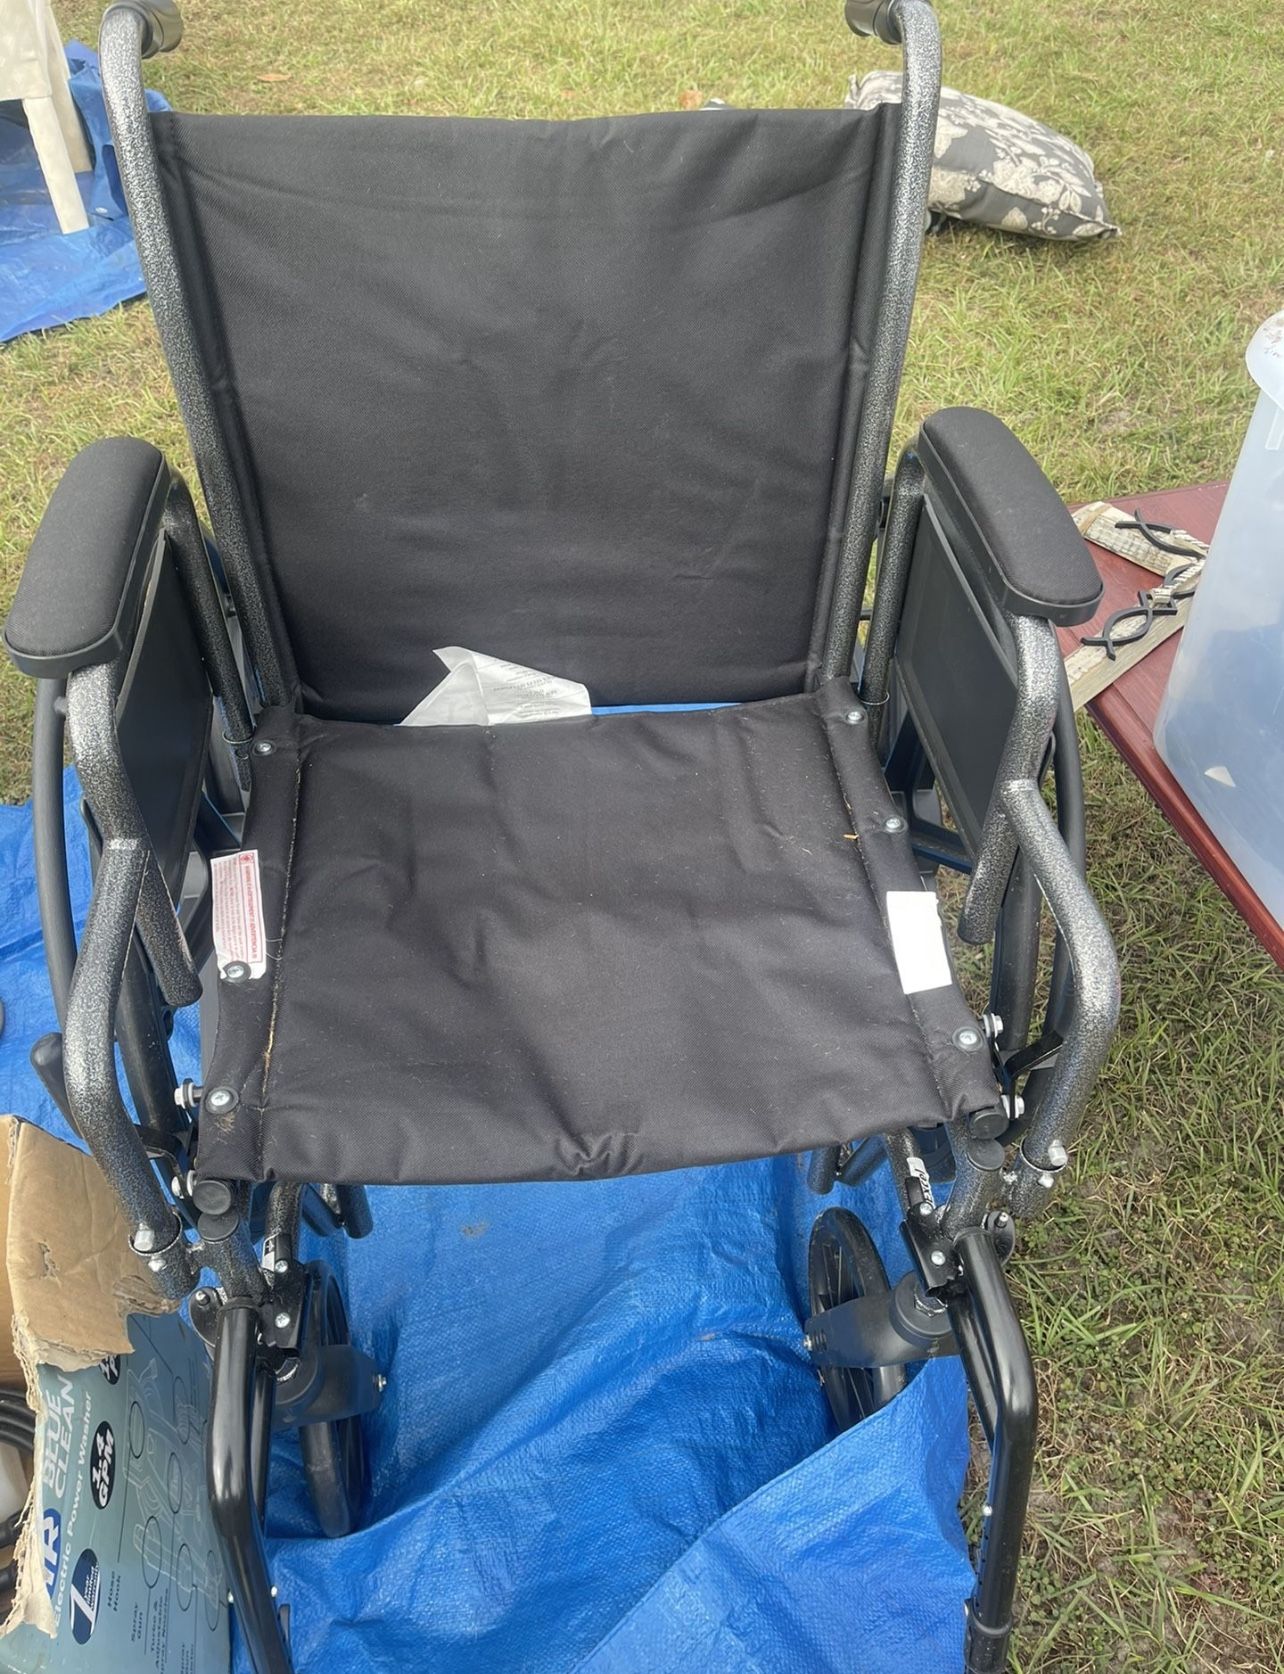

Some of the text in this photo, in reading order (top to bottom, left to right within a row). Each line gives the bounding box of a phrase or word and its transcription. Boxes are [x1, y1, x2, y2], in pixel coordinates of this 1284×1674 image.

[43, 1389, 61, 1489] BLUE
[55, 1374, 75, 1498] CLEAN
[92, 1432, 105, 1489] 1.4
[99, 1428, 114, 1507] GPM
[54, 1391, 91, 1628] Electric Power Washer
[107, 1571, 115, 1607] Hose
[113, 1575, 121, 1612] Hook
